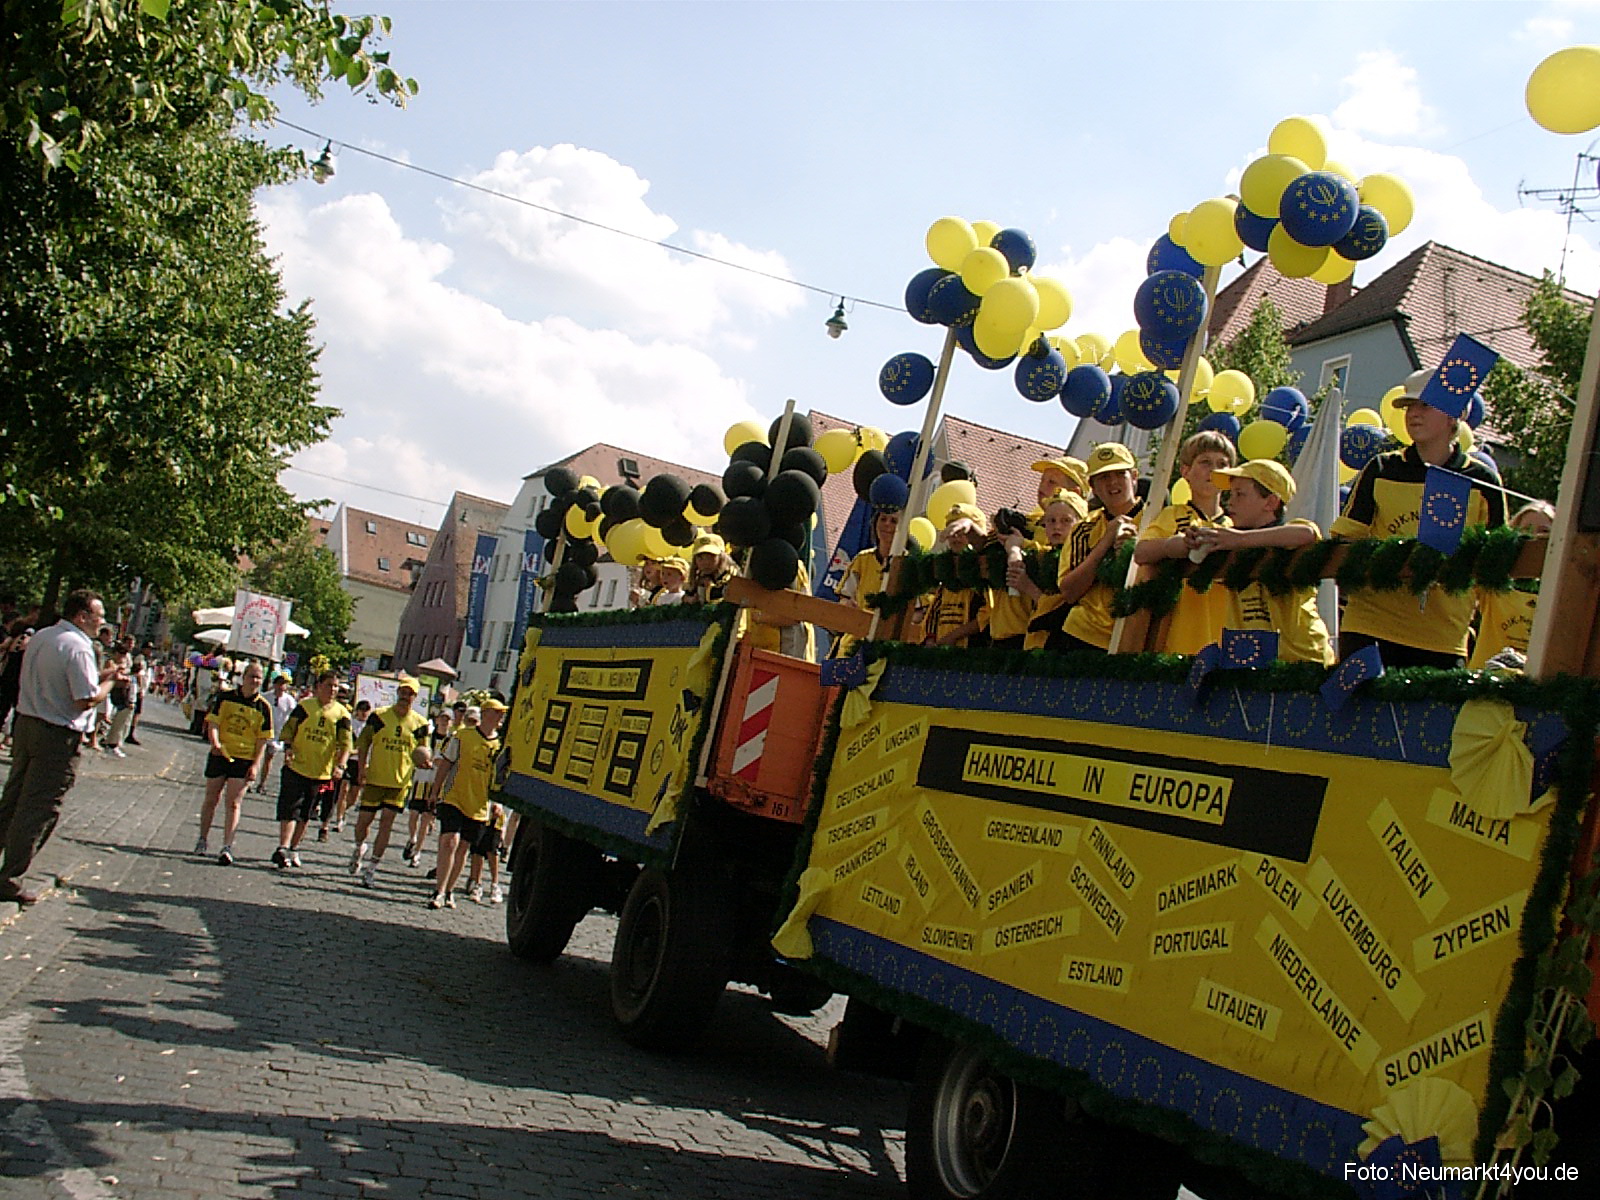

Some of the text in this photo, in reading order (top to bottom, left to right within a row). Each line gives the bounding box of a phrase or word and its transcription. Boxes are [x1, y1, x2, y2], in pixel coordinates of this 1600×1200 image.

[846, 723, 882, 762] BELGIEN
[884, 722, 921, 753] UNGARN
[835, 768, 896, 809] DEUTSCHLAND
[967, 751, 1225, 816] HANDBALL IN EUROPA
[771, 801, 789, 817] 161
[827, 815, 877, 845] TSCHECHIEN
[1449, 801, 1510, 846] MALTA
[987, 820, 1063, 847] GRIECHENLAND
[833, 837, 888, 883] FRANKREICH
[903, 854, 930, 898] IRLAND
[922, 809, 981, 910] GROSSBRITANNIEN
[1088, 825, 1137, 890] FINNLAND
[1381, 820, 1434, 899] ITALIEN
[861, 886, 901, 915] LETTLAND
[987, 869, 1034, 911] SPANIEN
[1070, 865, 1125, 936] SCHWEDEN
[1158, 863, 1238, 912] DÄNEMARK
[1255, 857, 1303, 911] POLEN
[921, 926, 974, 951] SLOWENIEN
[1153, 927, 1229, 955] PORTUGAL
[1321, 878, 1402, 991] LUXEMBURG
[1432, 905, 1511, 960] ZYPERN
[1067, 960, 1123, 987] ESTLAND
[1269, 933, 1361, 1051] NIEDERLANDE
[1207, 988, 1268, 1031] LITAUEN
[1384, 1020, 1486, 1086] SLOWAKEI
